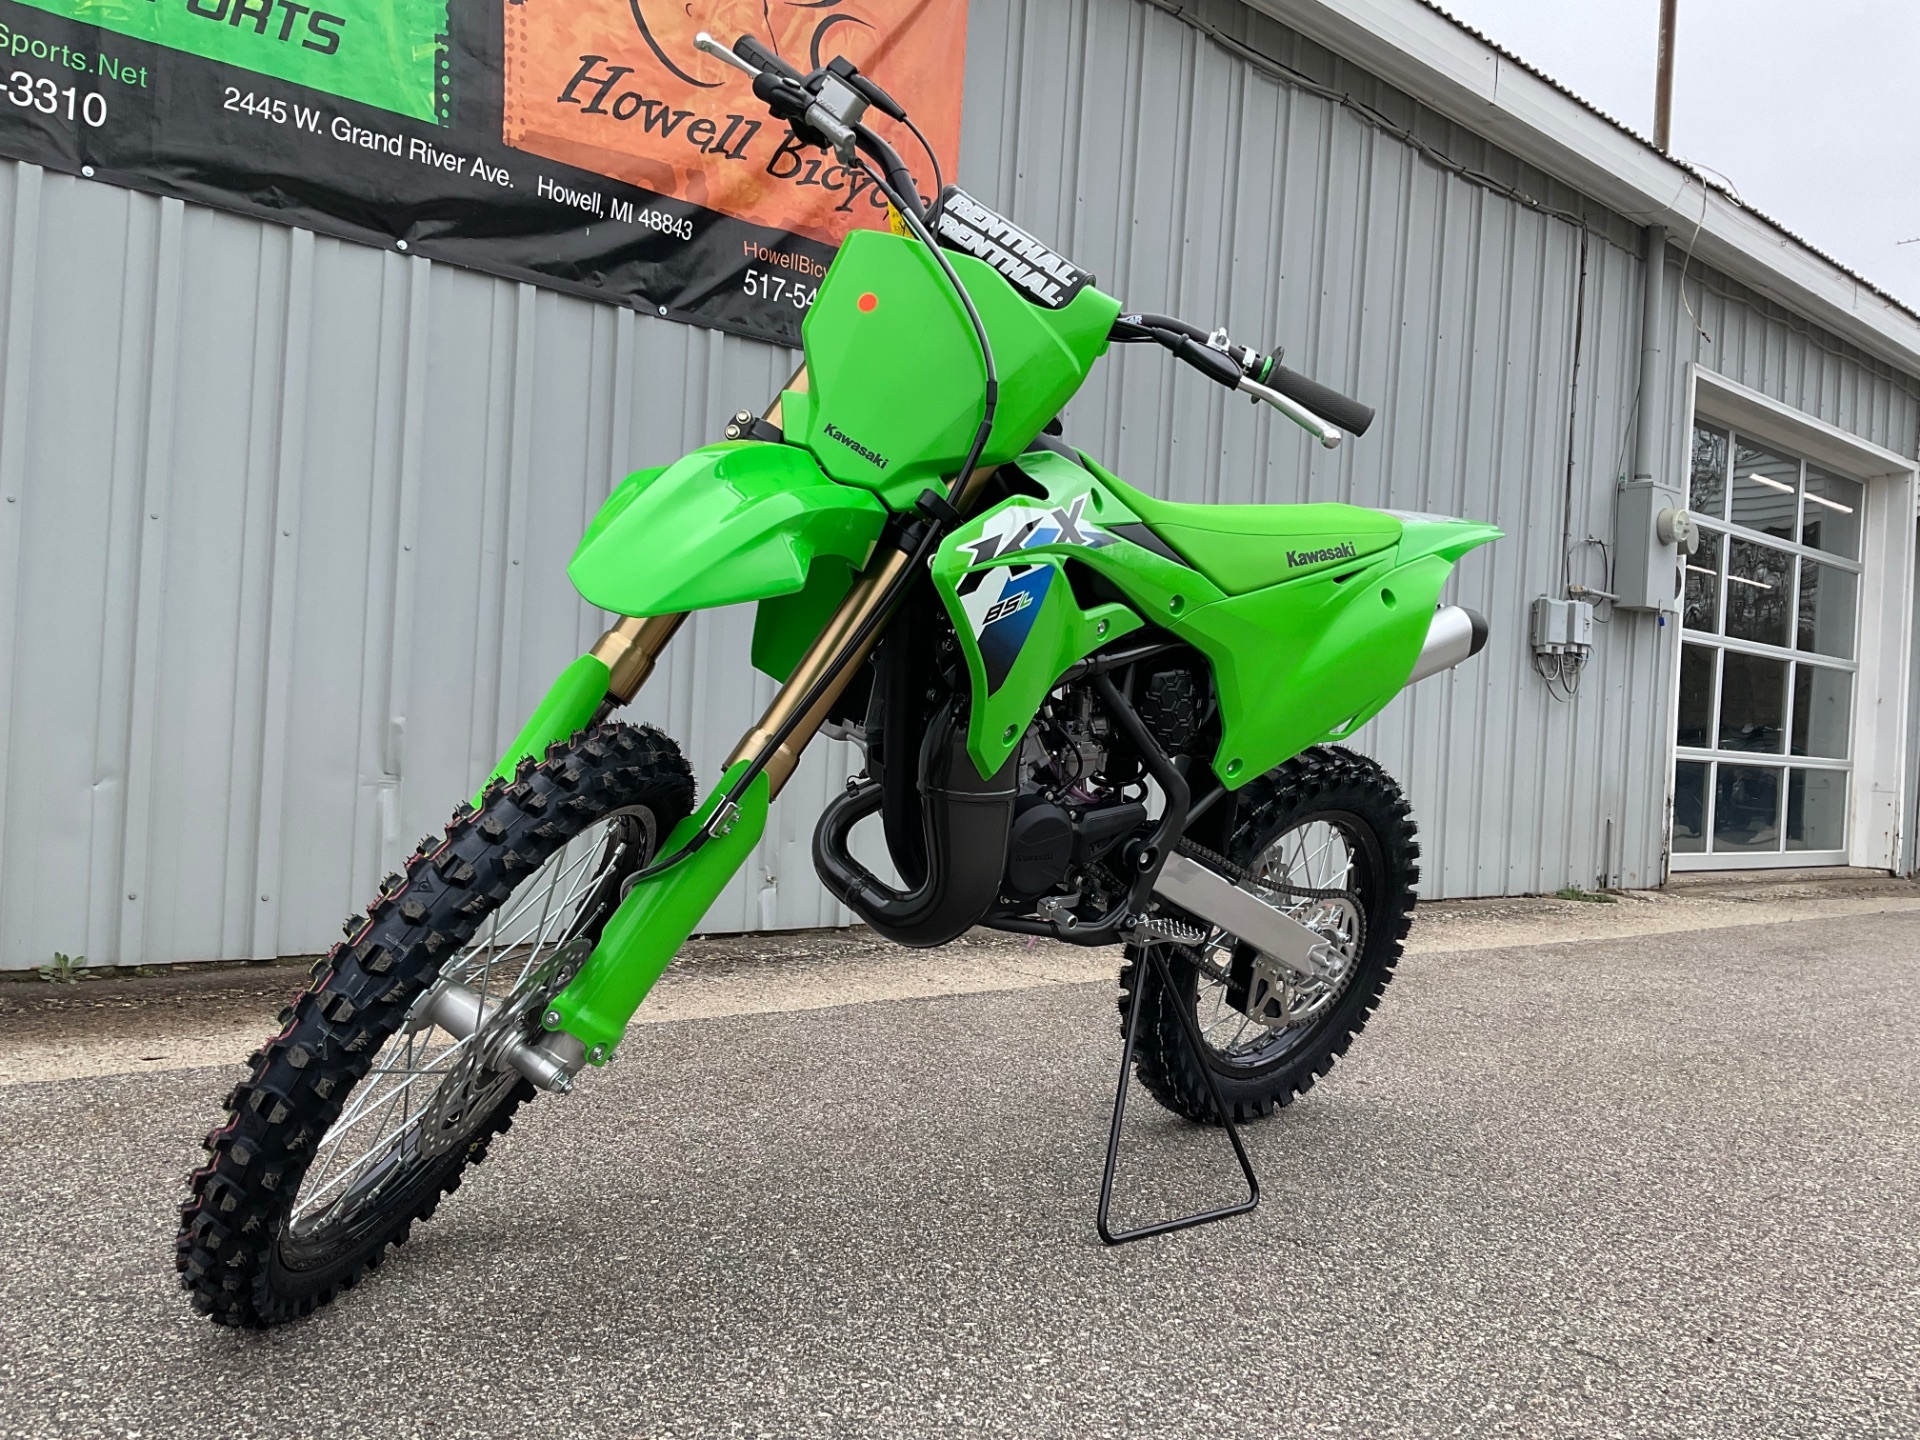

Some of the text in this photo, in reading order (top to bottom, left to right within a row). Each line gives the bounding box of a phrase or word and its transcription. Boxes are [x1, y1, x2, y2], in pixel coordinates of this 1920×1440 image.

[146, 0, 346, 55] ORTS
[557, 55, 762, 160] Howell
[223, 87, 693, 241] 2445 W. Grand River Ave. Howell, MI 48843
[931, 213, 1063, 307] RENTHAL
[944, 193, 1077, 288] RENTHAL
[823, 423, 890, 470] Kawasaki
[1285, 541, 1357, 568] Kawasaki
